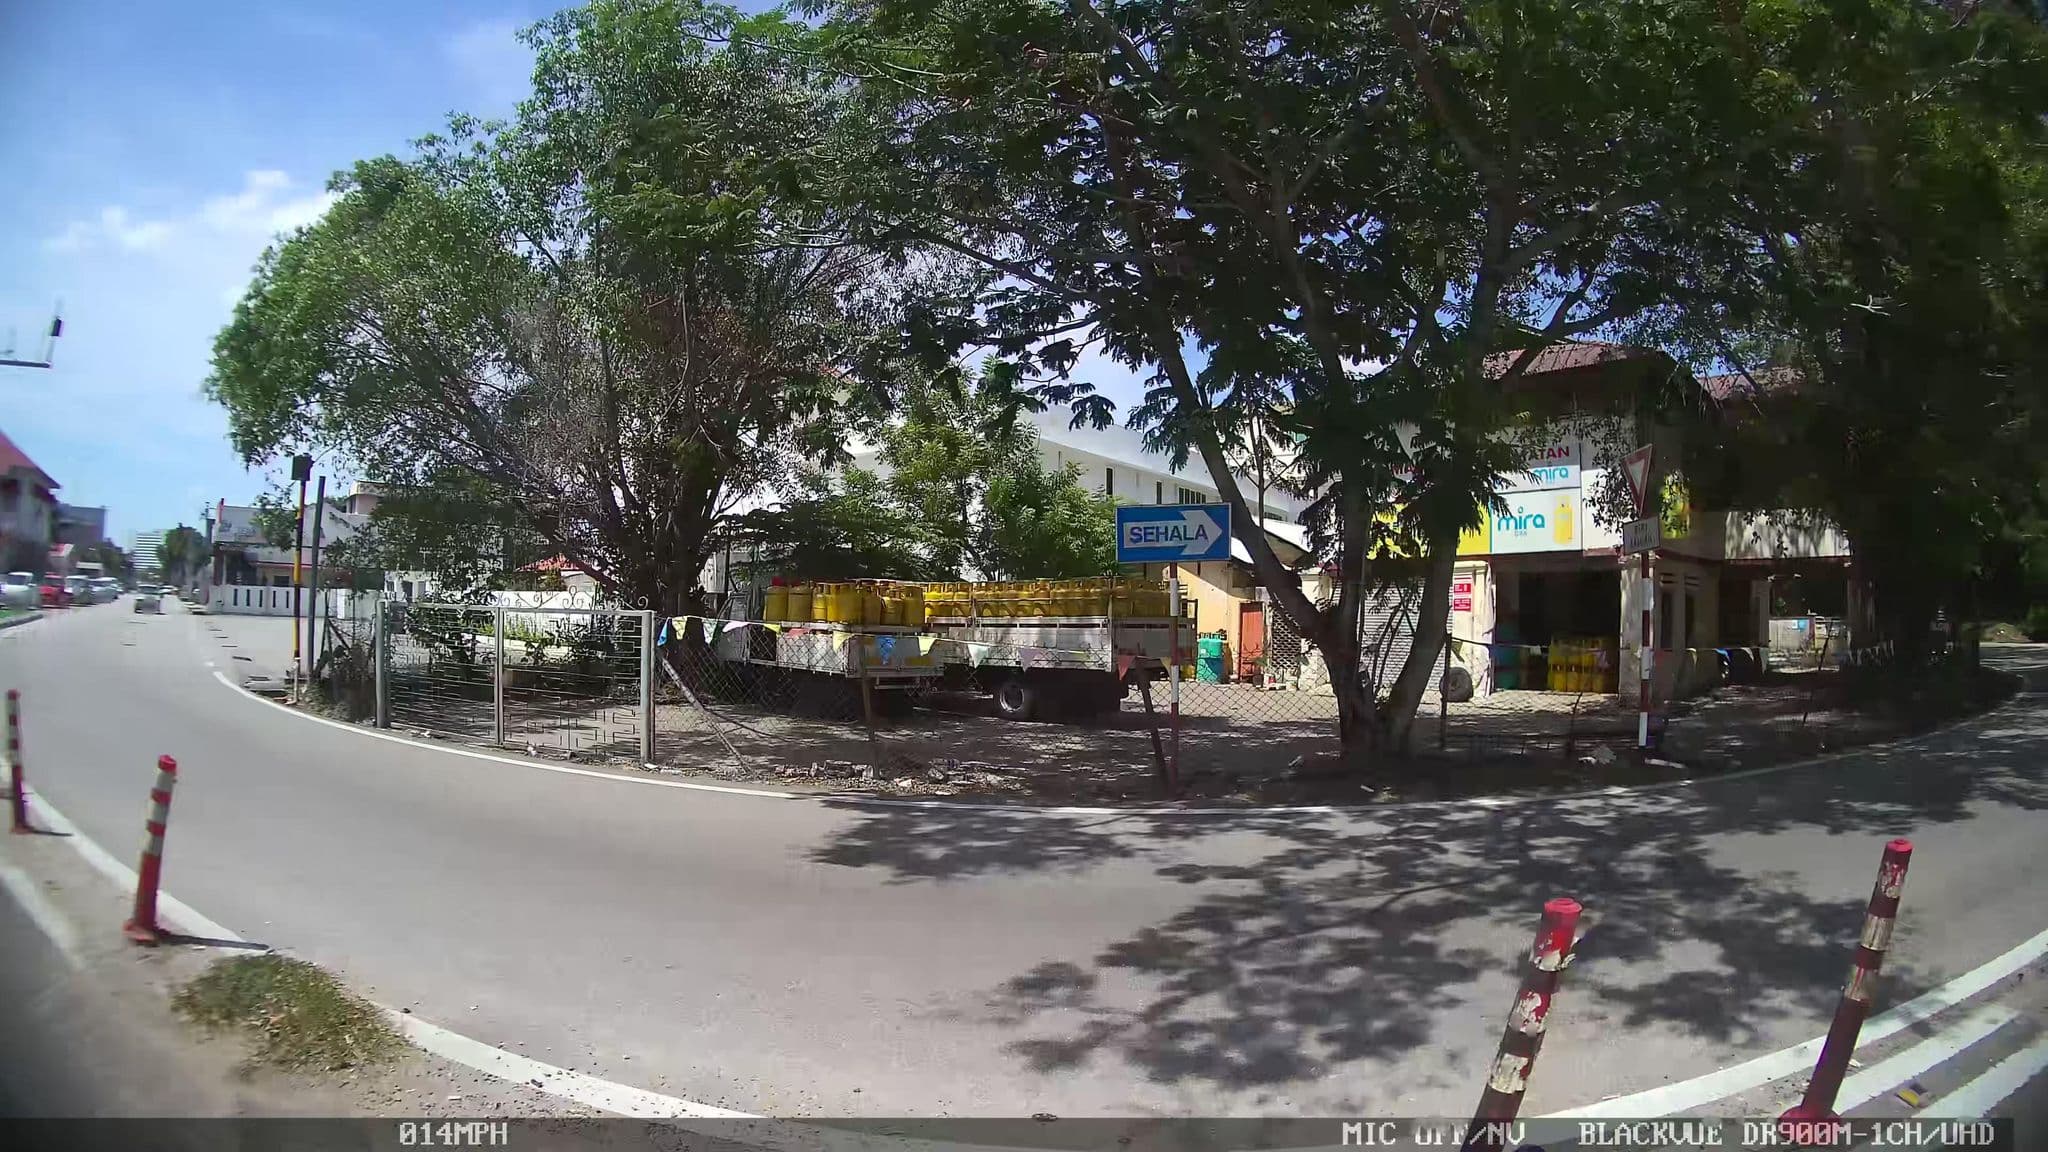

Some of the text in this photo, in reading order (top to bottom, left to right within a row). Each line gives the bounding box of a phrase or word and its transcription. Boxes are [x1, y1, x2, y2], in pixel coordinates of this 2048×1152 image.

[1533, 466, 1569, 481] mira
[1497, 508, 1545, 531] mira
[1129, 524, 1209, 545] SEHALA
